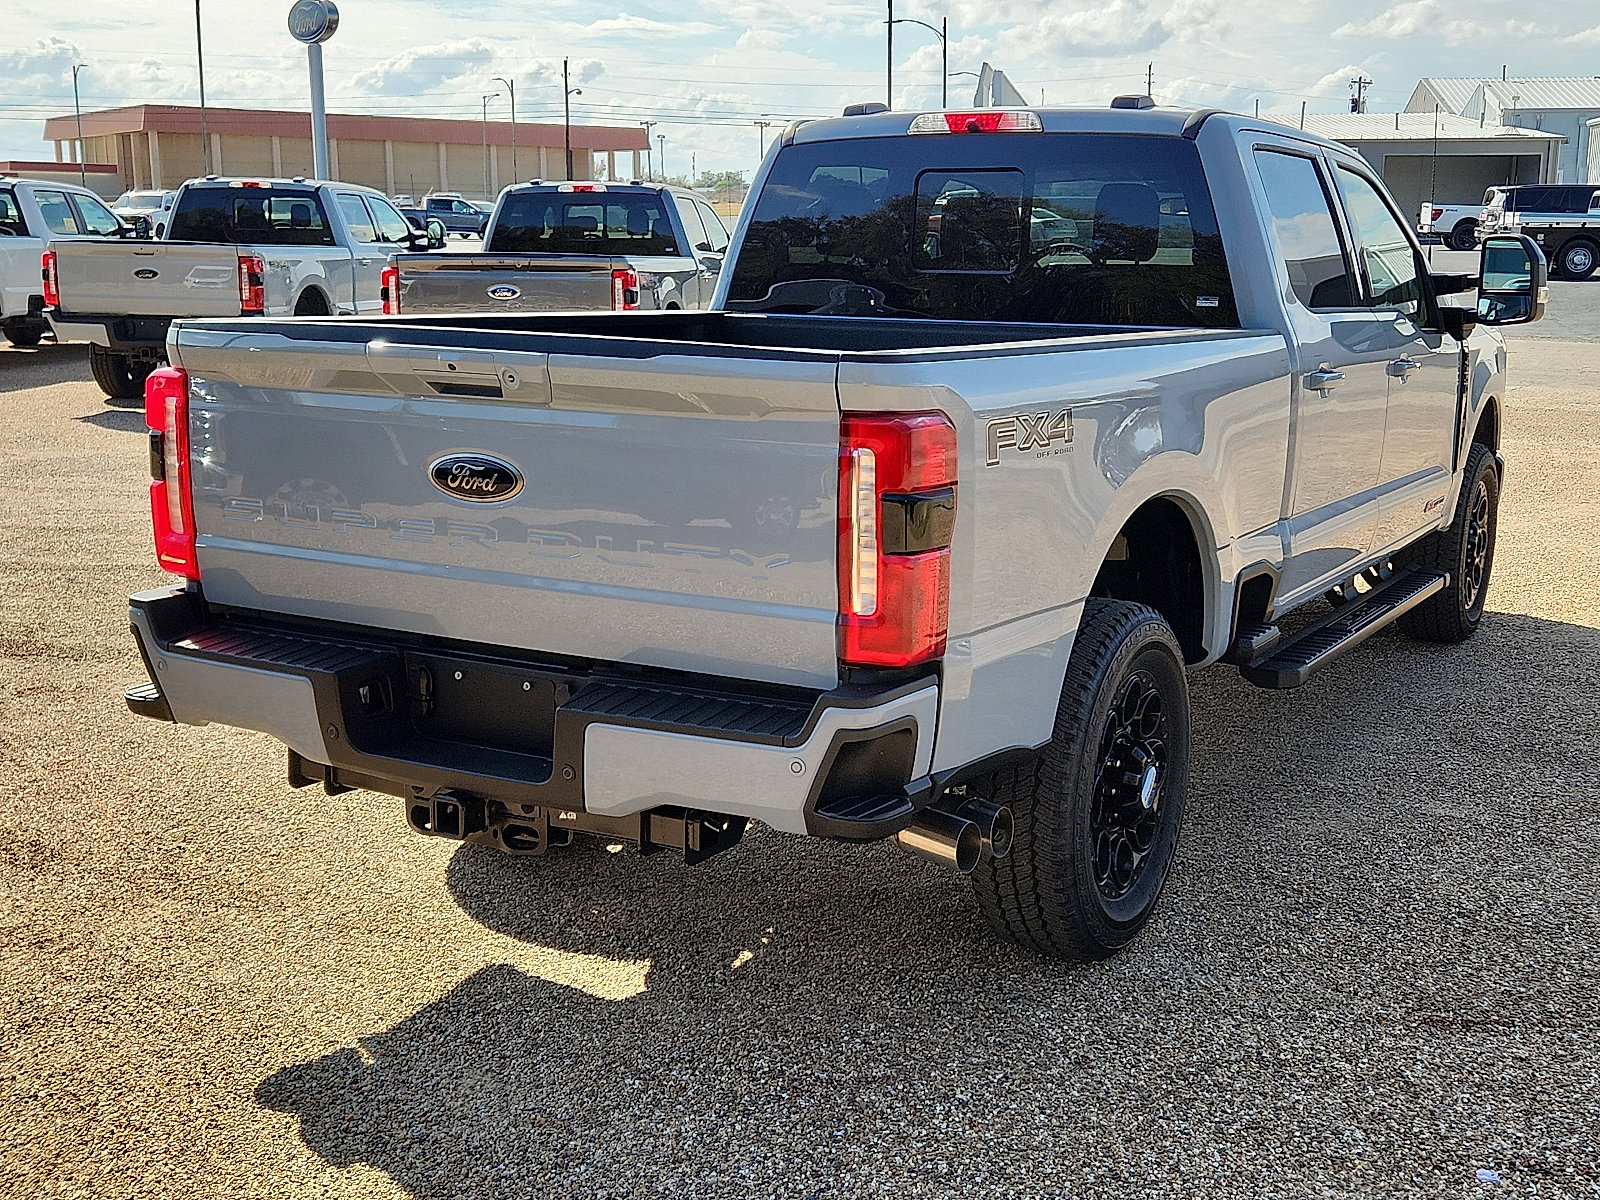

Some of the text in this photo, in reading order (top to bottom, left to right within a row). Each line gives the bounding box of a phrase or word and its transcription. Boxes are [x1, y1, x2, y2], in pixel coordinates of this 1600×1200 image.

[294, 5, 318, 34] Ford
[494, 288, 513, 297] Ford
[985, 407, 1075, 468] FX4
[1036, 446, 1074, 459] OFF ROAD
[447, 462, 499, 492] Ford
[222, 496, 791, 581] SUPER DUTY
